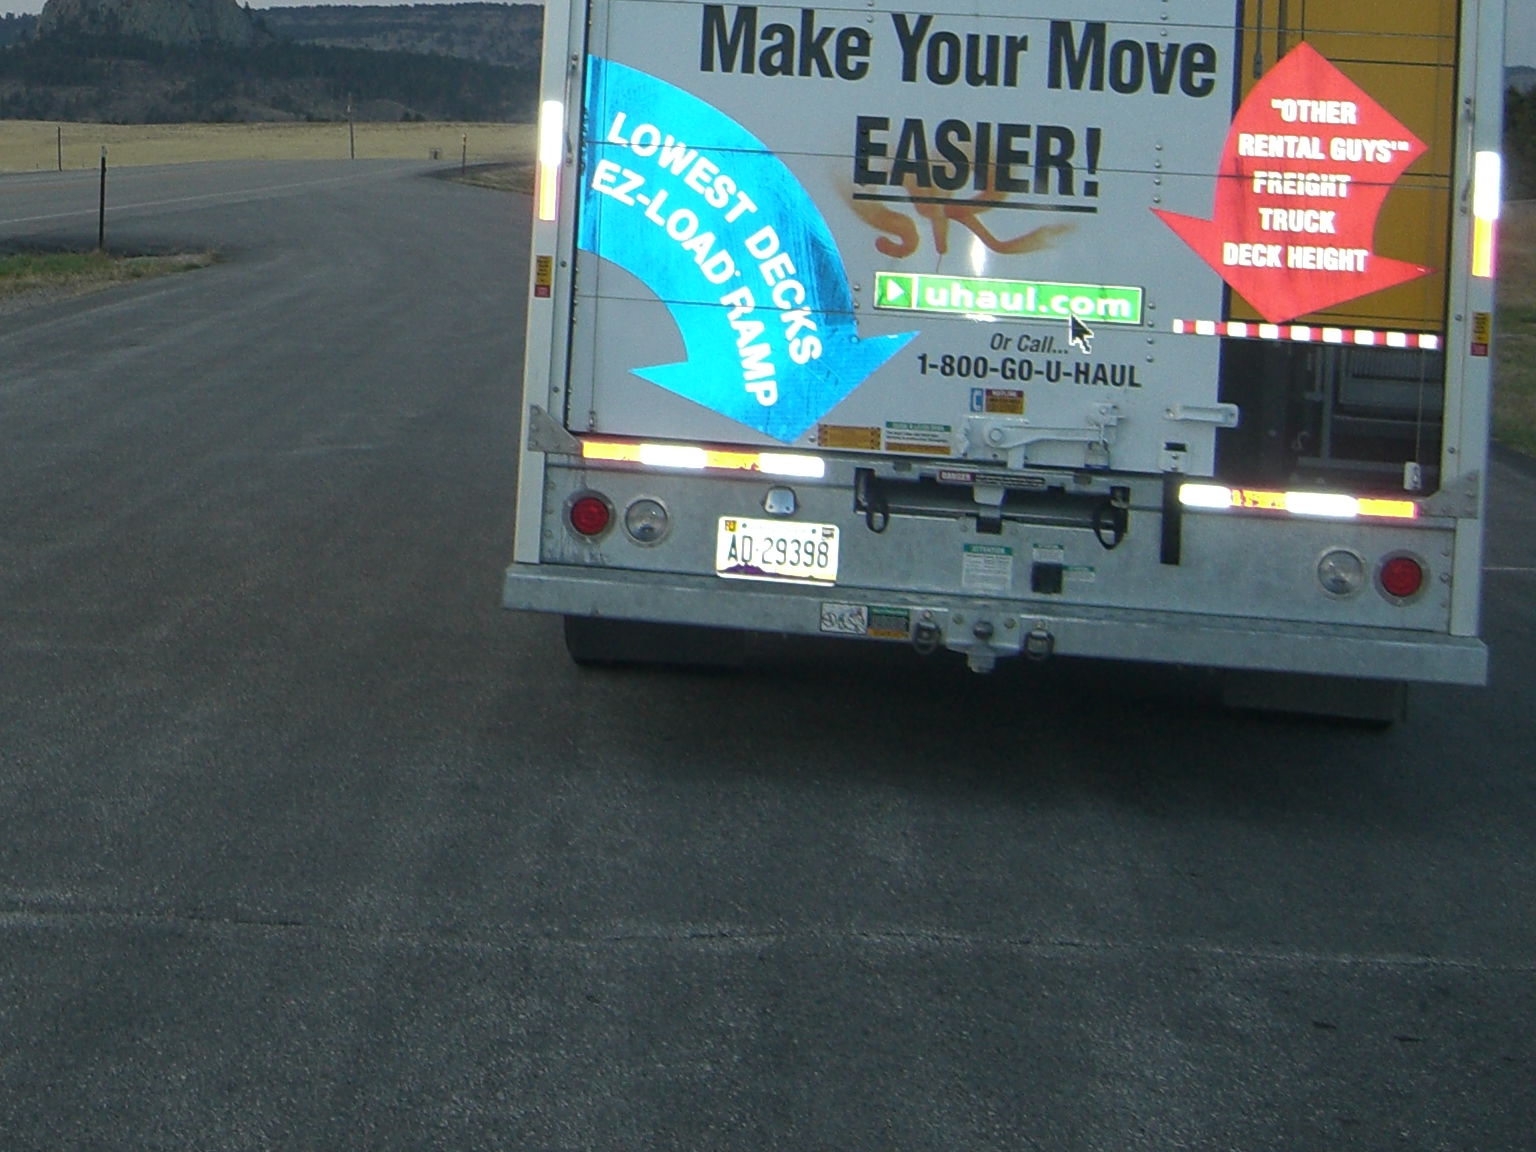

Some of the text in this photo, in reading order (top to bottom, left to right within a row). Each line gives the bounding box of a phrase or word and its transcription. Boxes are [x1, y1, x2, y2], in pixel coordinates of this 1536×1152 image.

[700, 4, 1218, 98] Make Your Move
[852, 114, 1102, 197] EASIER!
[1237, 132, 1326, 161] RENTAL
[1252, 170, 1352, 198] FREIGHT
[606, 110, 823, 365] LOWEST DECKS
[1258, 206, 1336, 235] TRUCK
[1222, 241, 1370, 272] DECK HEIGHT
[924, 281, 1133, 318] uhaul.com
[719, 285, 779, 407] RAMP
[990, 332, 1008, 351] Or
[916, 352, 1143, 389] 1-800-GO-U-HAUL
